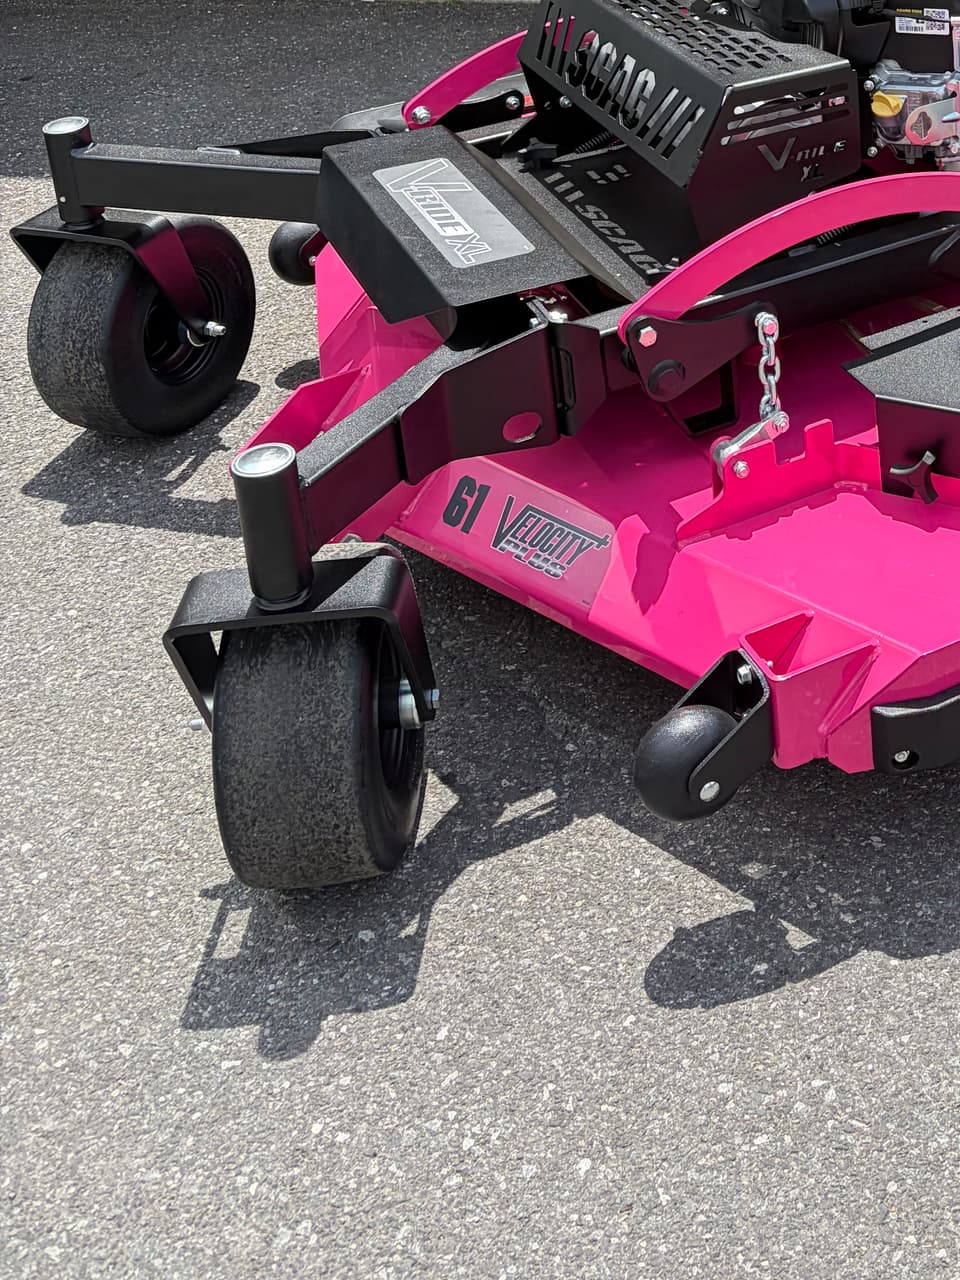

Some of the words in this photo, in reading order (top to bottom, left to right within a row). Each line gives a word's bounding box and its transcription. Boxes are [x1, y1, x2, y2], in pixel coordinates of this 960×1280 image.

[565, 30, 656, 131] SCAG
[445, 232, 492, 264] XL
[575, 205, 664, 274] SCAG
[443, 475, 491, 534] 61
[490, 495, 612, 567] VELOCITY
[498, 538, 568, 580] PLUS
